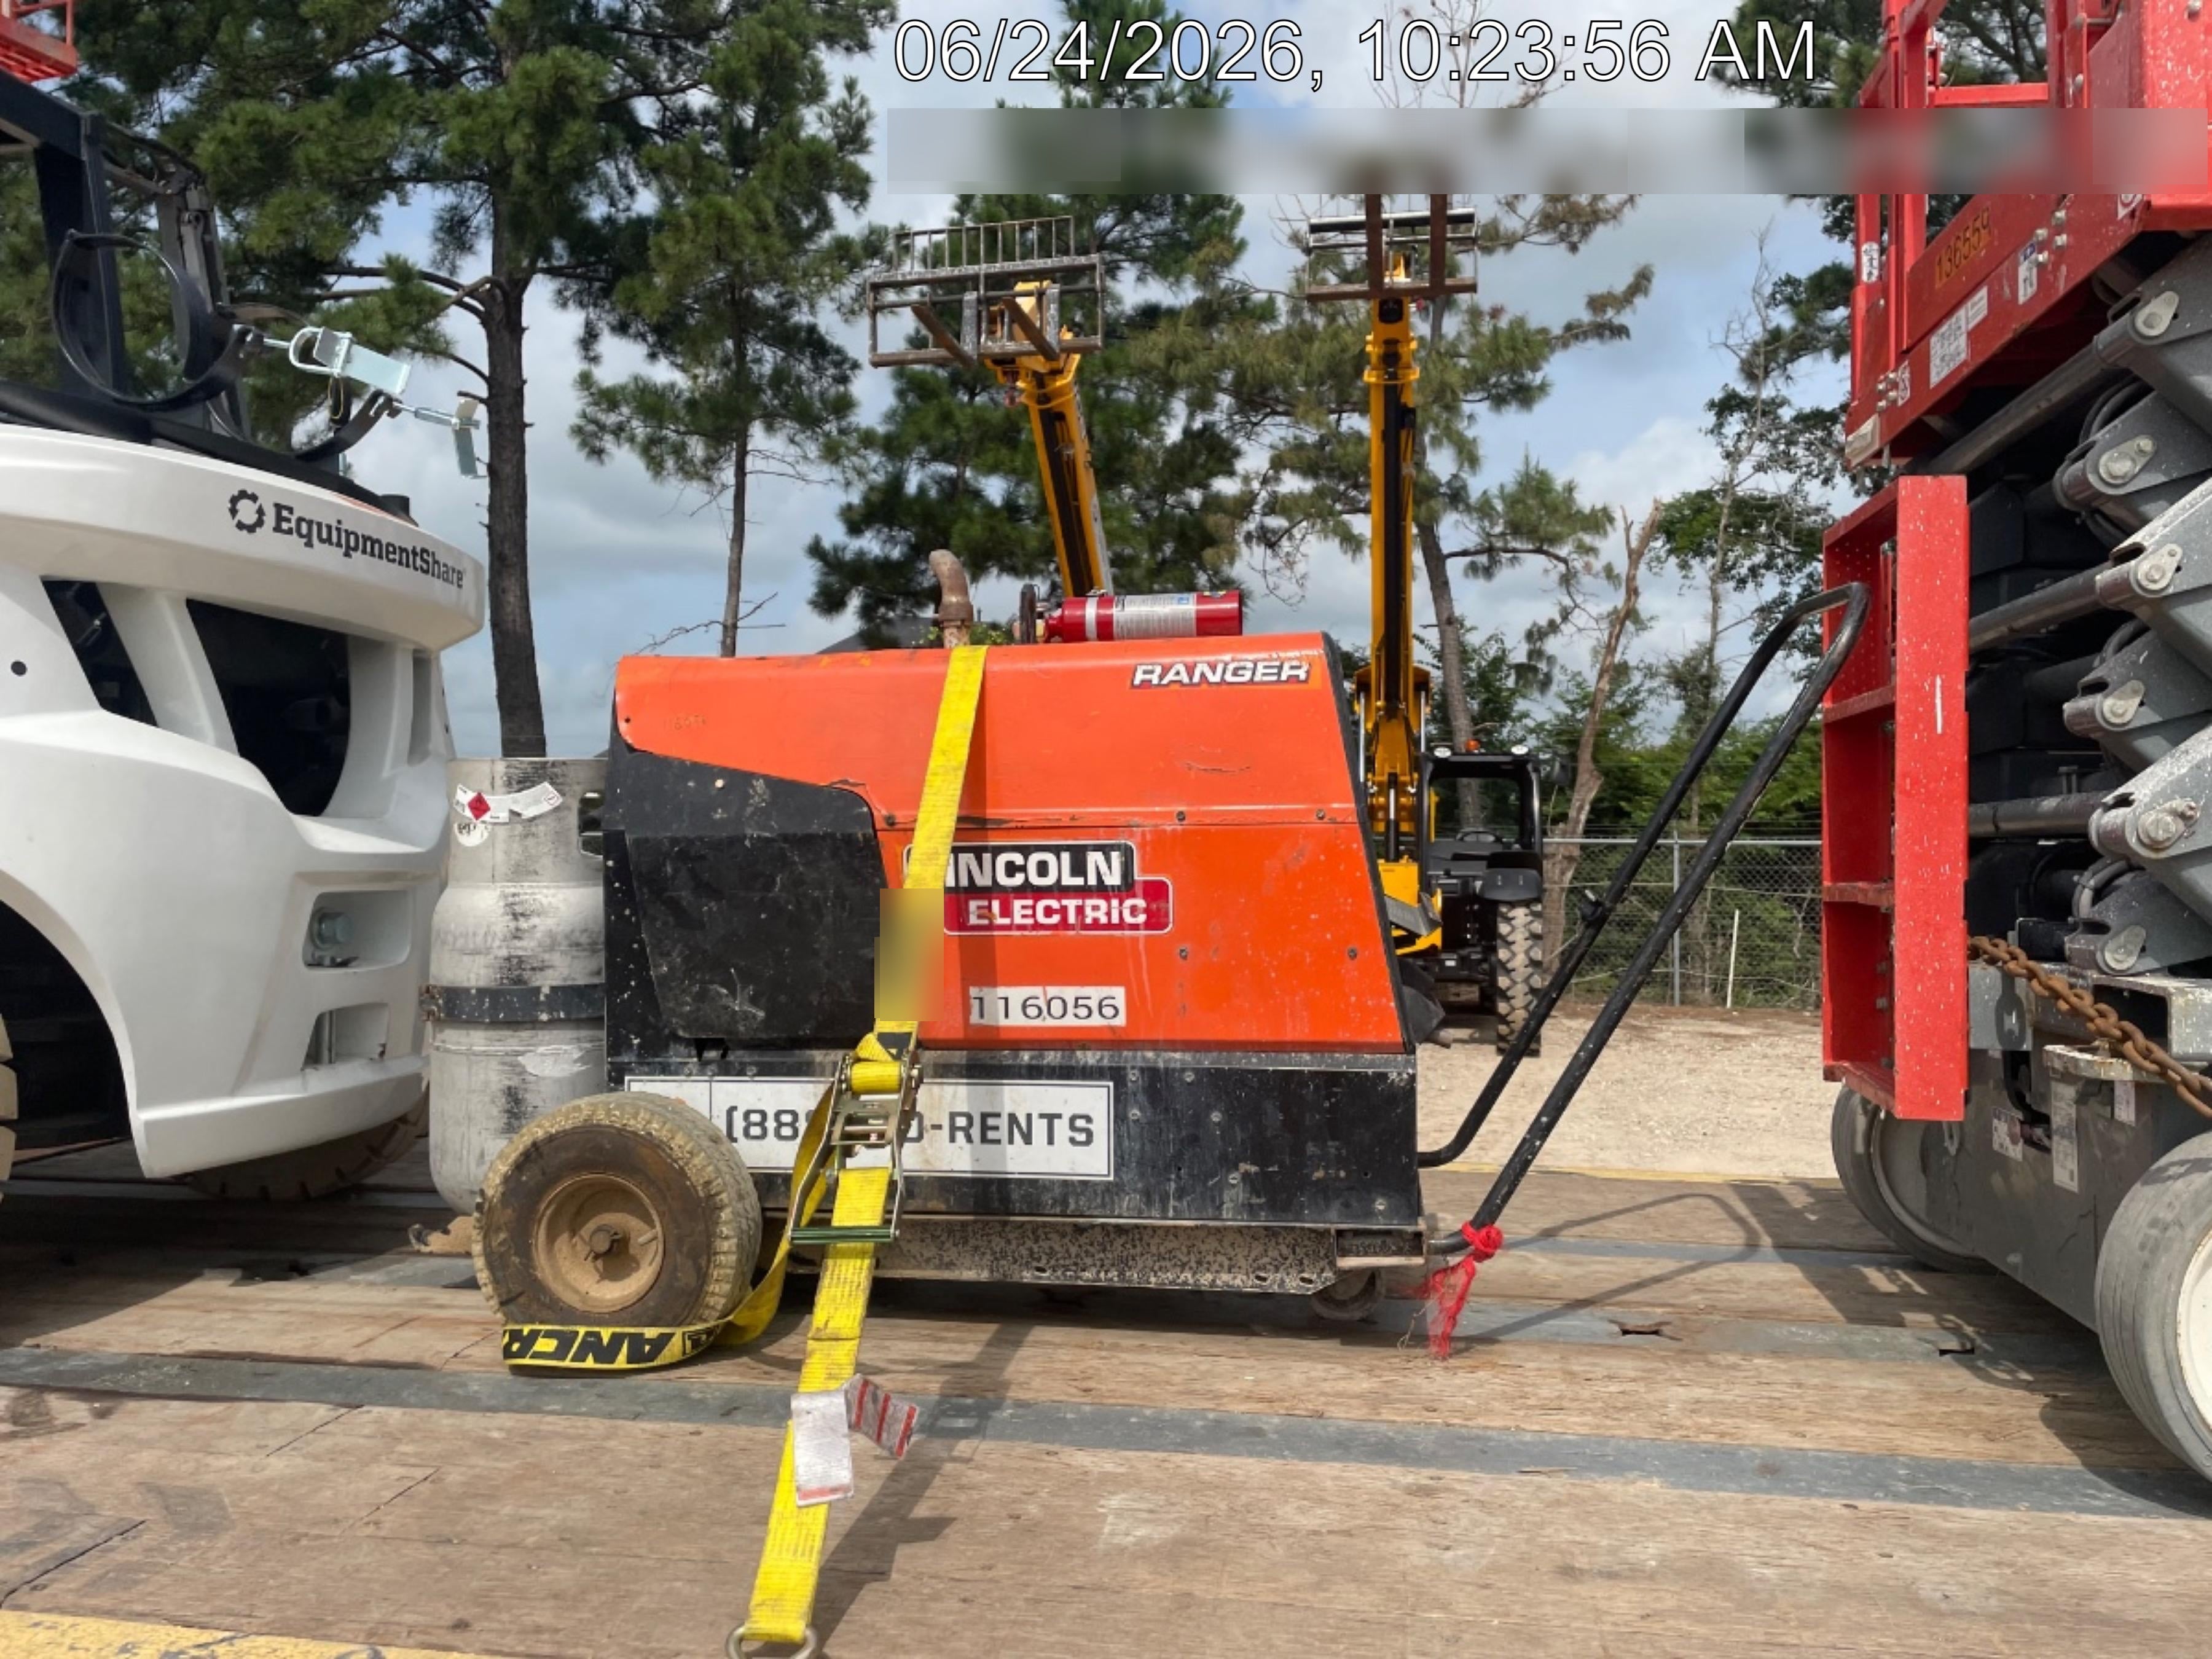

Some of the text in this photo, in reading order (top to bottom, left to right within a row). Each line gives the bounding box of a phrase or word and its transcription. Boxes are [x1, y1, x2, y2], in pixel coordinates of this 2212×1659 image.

[272, 503, 464, 589] EquipmentShare
[1131, 660, 1311, 688] RANGER
[945, 851, 1122, 887] INCOLN
[968, 898, 1147, 926] ELECTRIC
[972, 995, 1120, 1020] 116056
